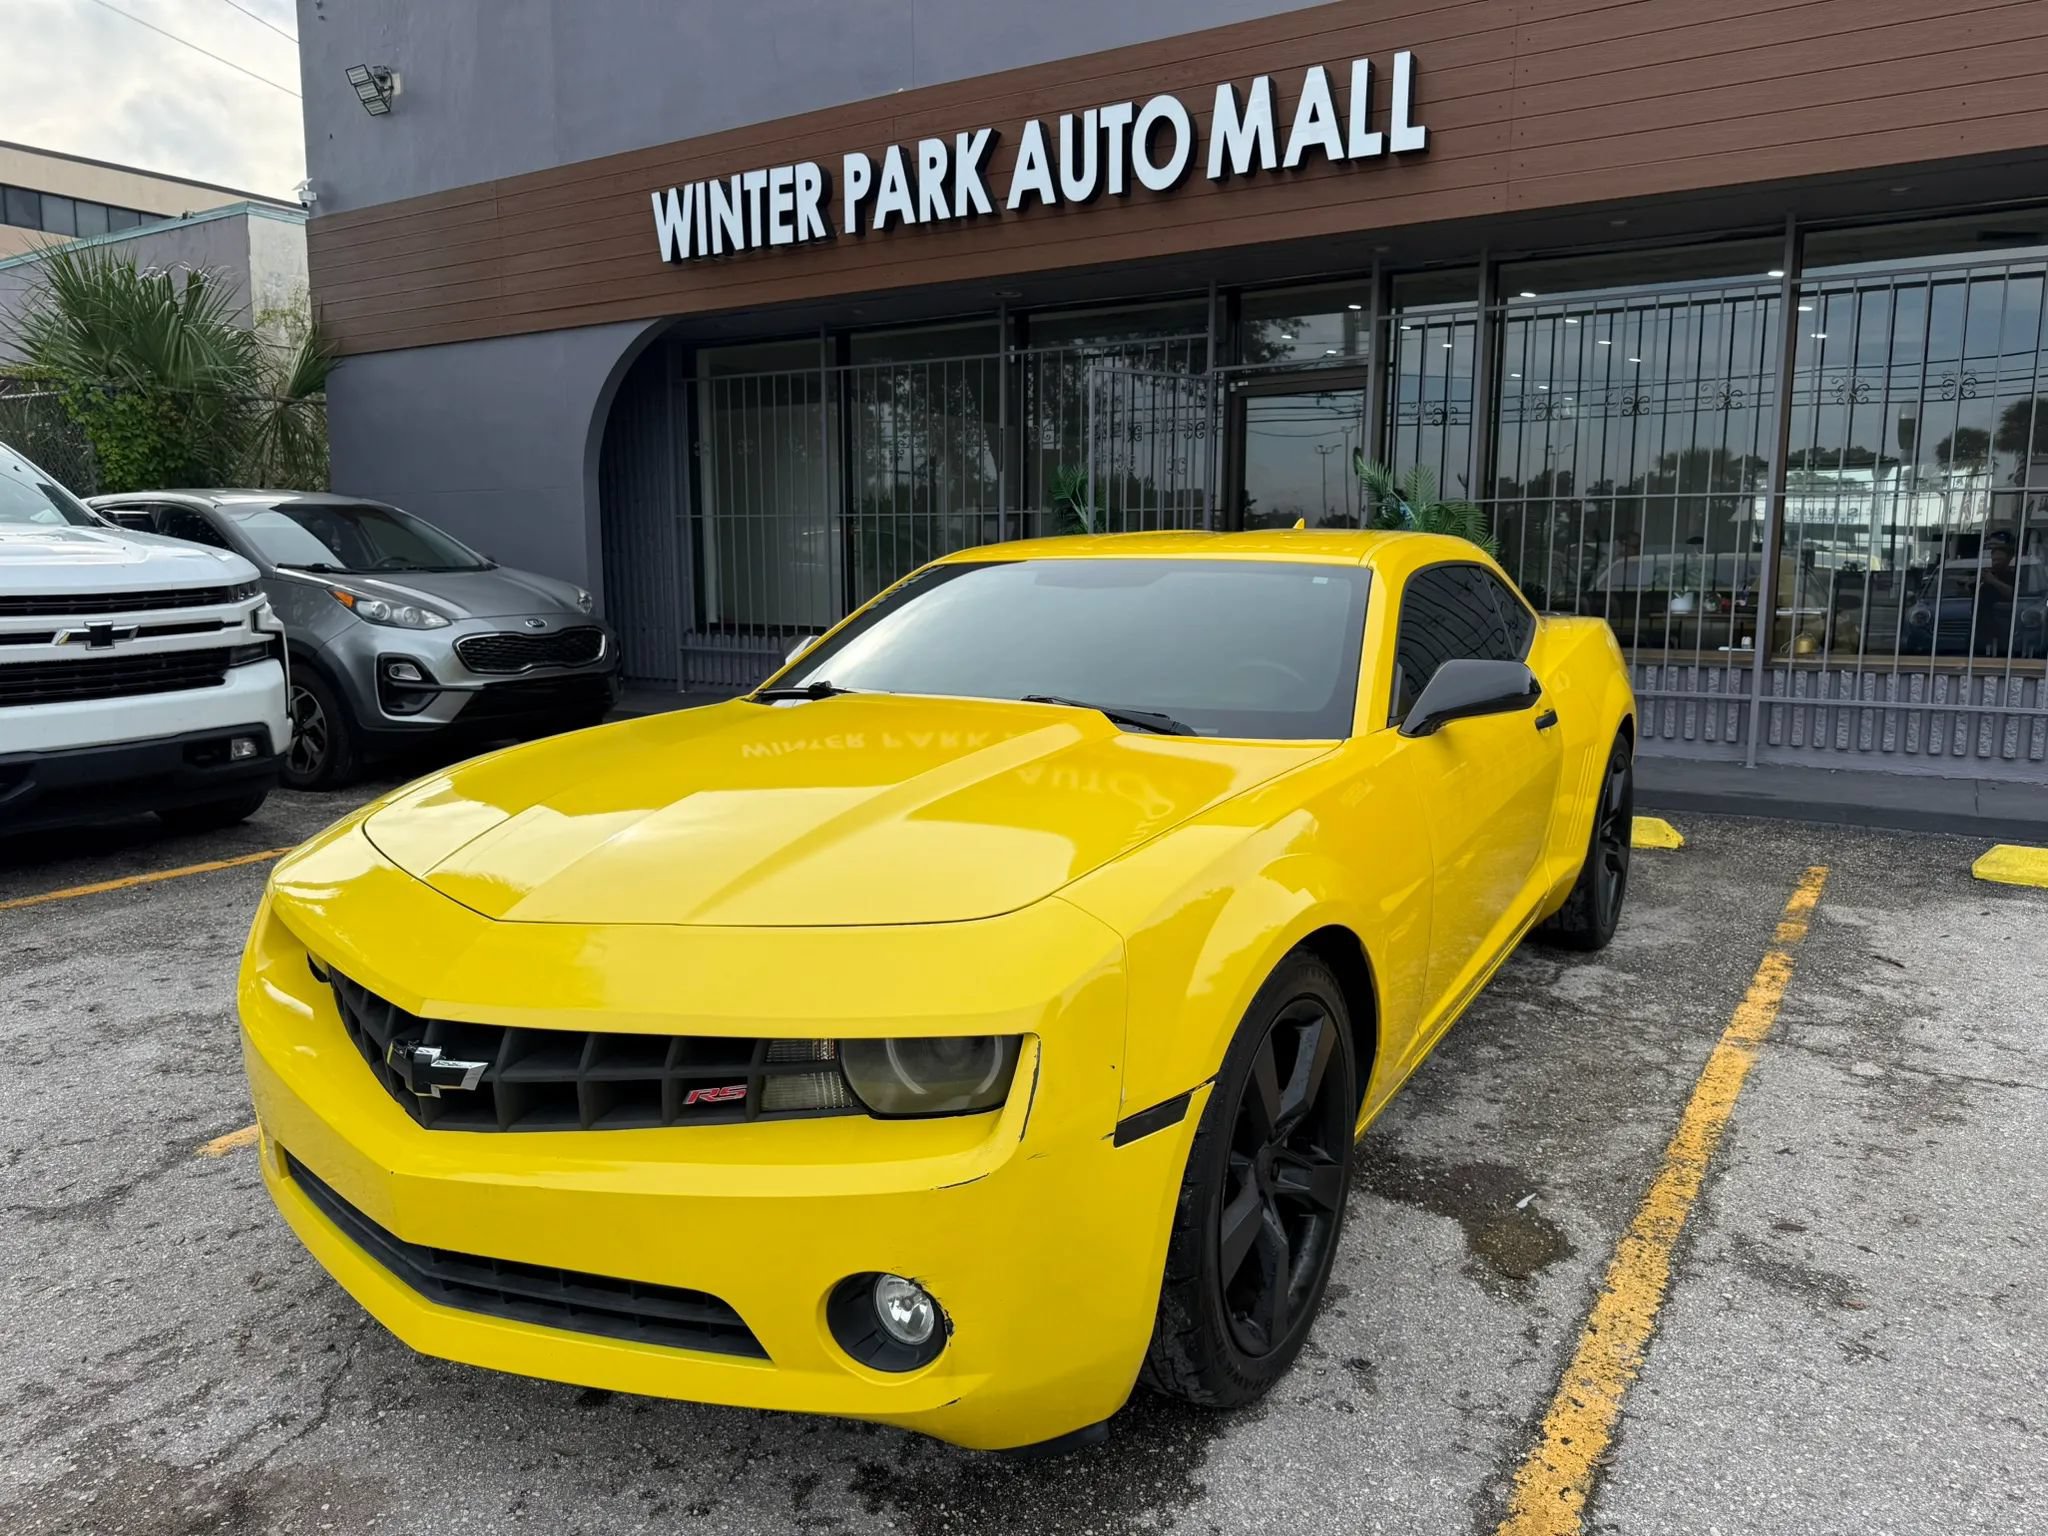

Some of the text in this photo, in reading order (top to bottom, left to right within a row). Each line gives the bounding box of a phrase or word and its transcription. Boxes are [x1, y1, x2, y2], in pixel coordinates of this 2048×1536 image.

[651, 50, 1426, 262] WINTER PARK AUTO MALL
[683, 1084, 748, 1104] RS
